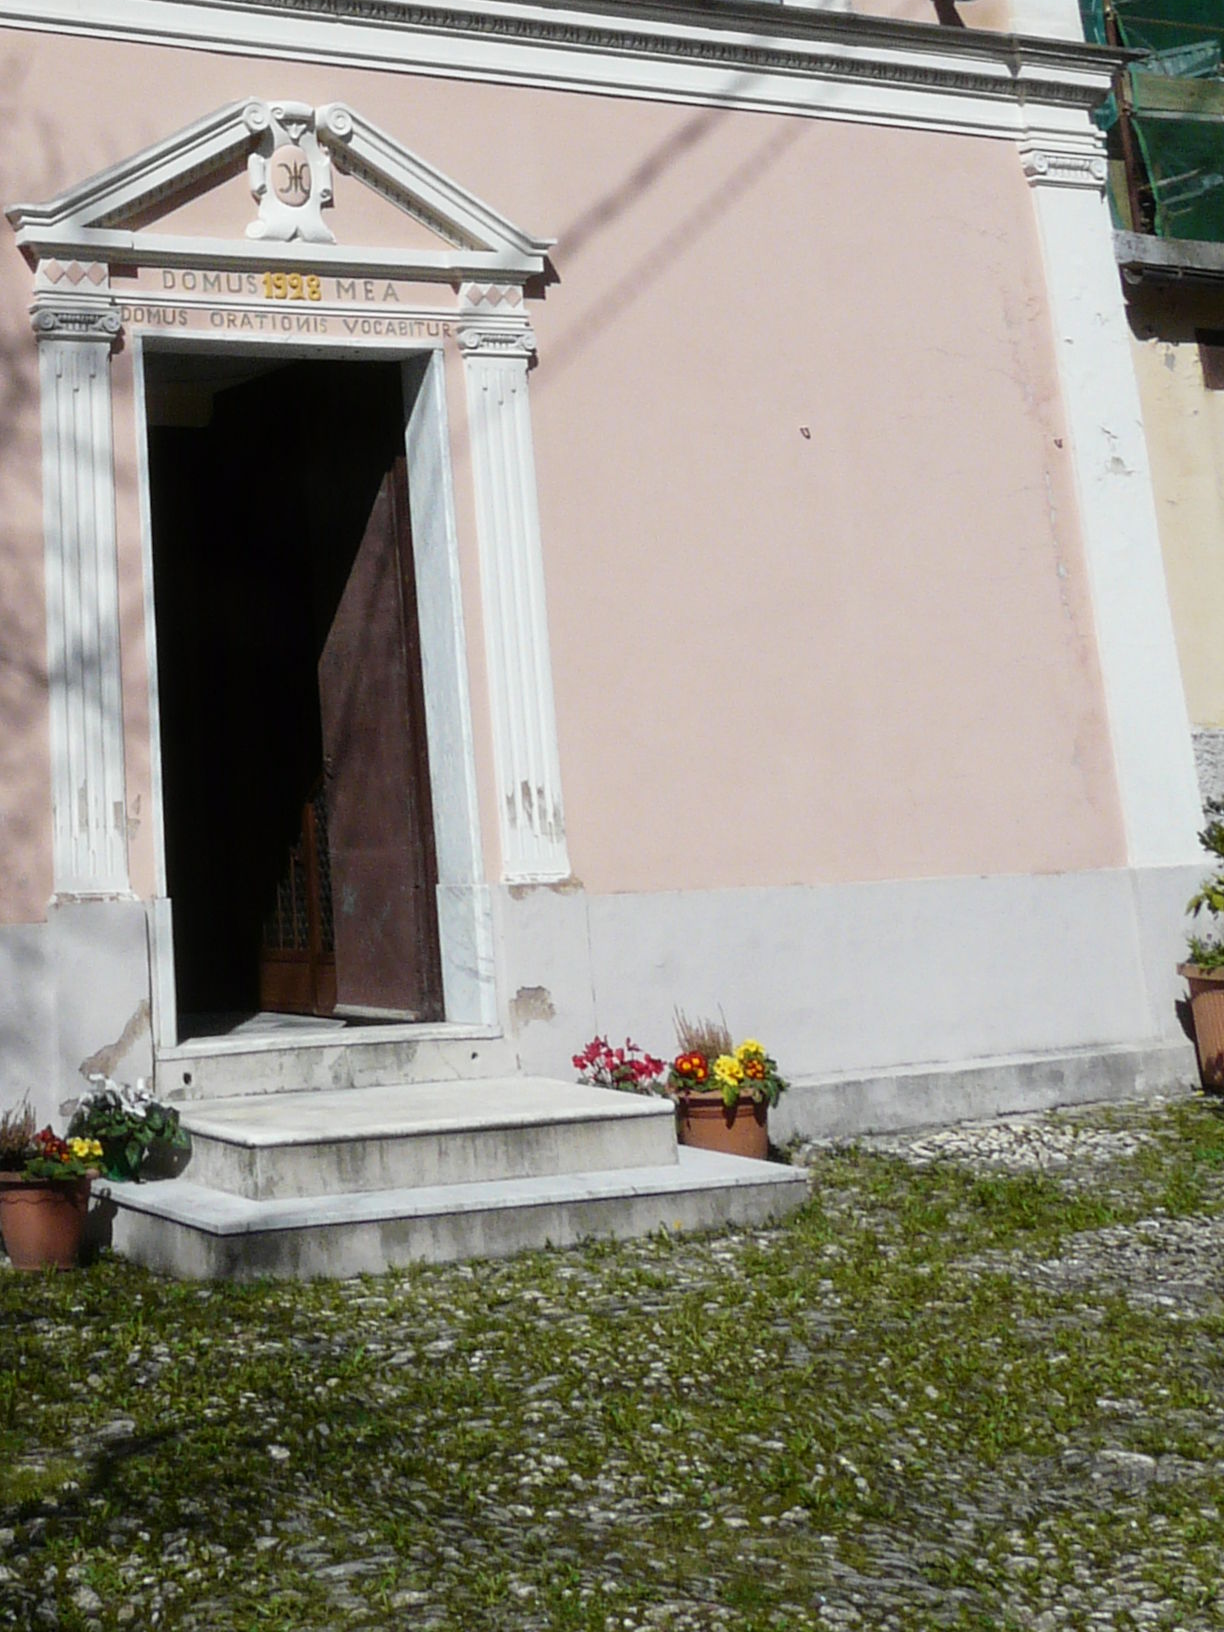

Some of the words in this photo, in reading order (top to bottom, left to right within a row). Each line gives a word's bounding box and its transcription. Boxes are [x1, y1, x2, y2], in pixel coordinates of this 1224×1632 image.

[162, 270, 258, 294] DOMUS
[262, 271, 323, 301] 1928
[335, 279, 400, 302] MEA
[121, 306, 188, 326] DOMUS
[343, 319, 453, 337] VOCABITUR
